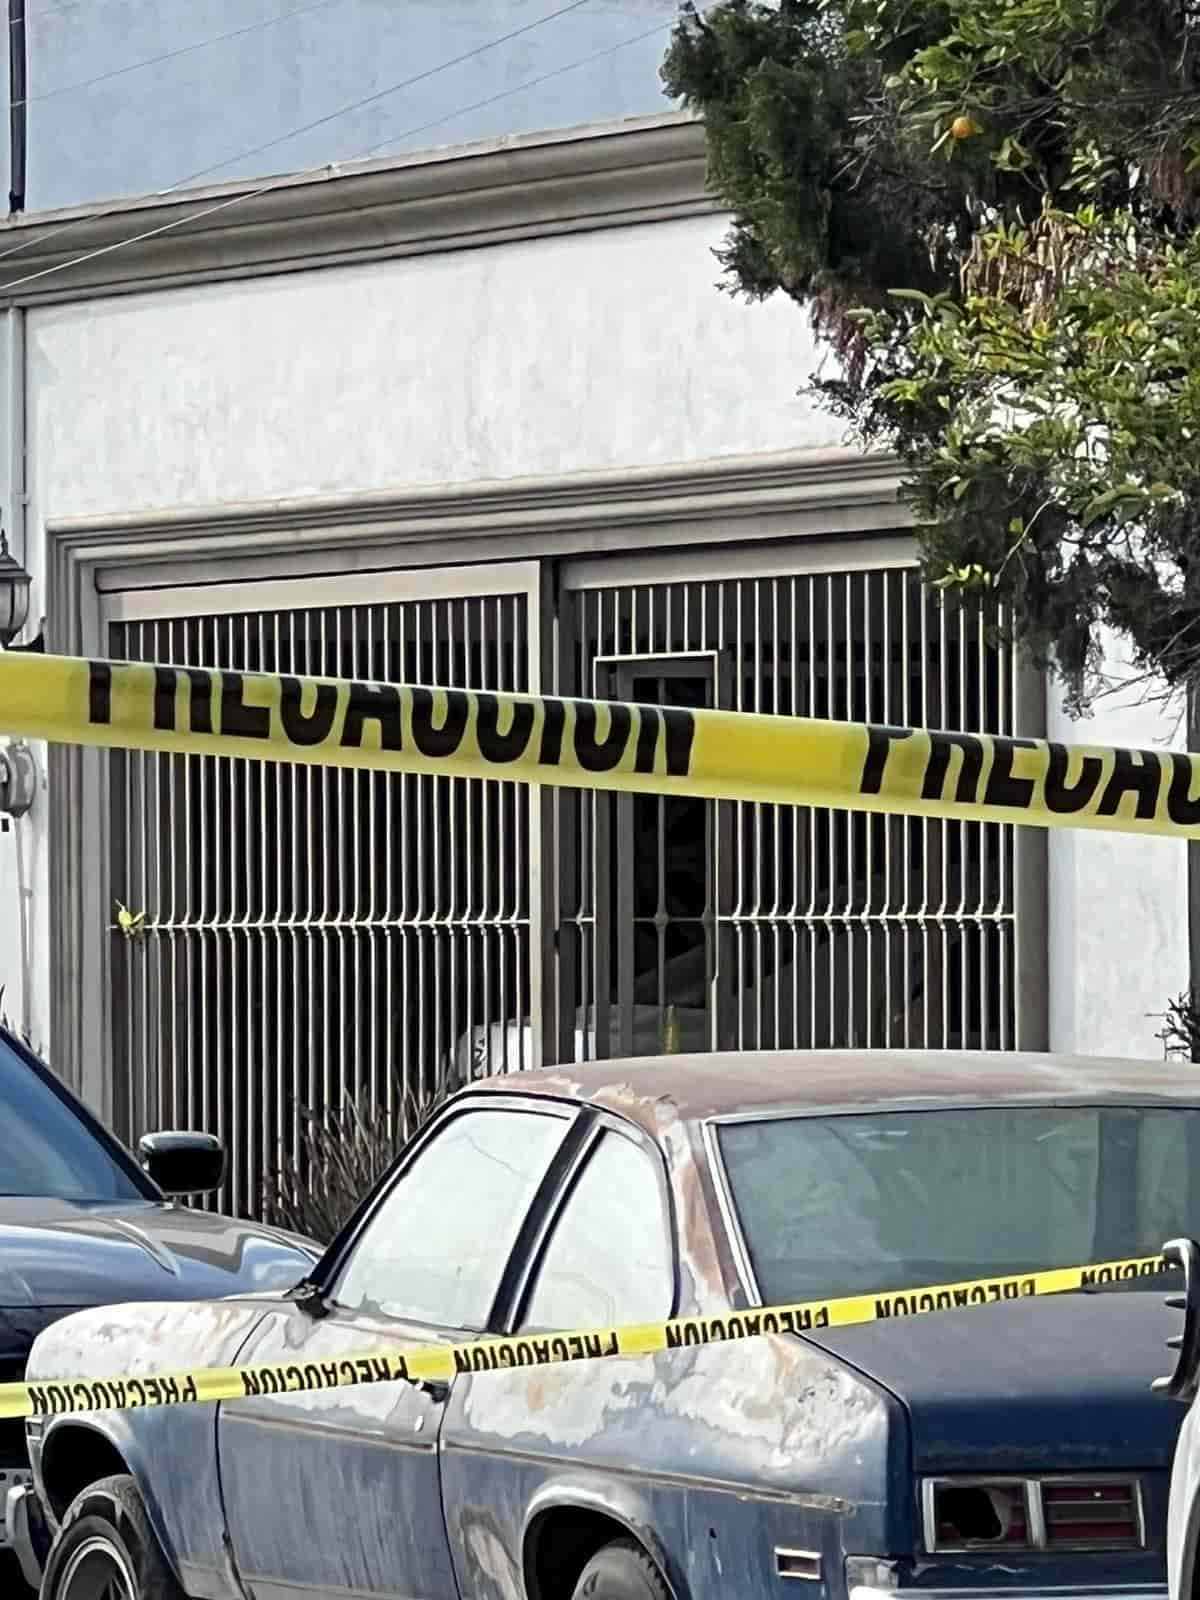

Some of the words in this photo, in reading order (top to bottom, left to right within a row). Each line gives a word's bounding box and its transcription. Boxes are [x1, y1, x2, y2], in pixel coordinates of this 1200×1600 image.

[28, 1375, 198, 1416] PRECAUCION
[241, 1355, 410, 1397] PRECAUCION
[453, 1332, 620, 1374] PRECAUCION
